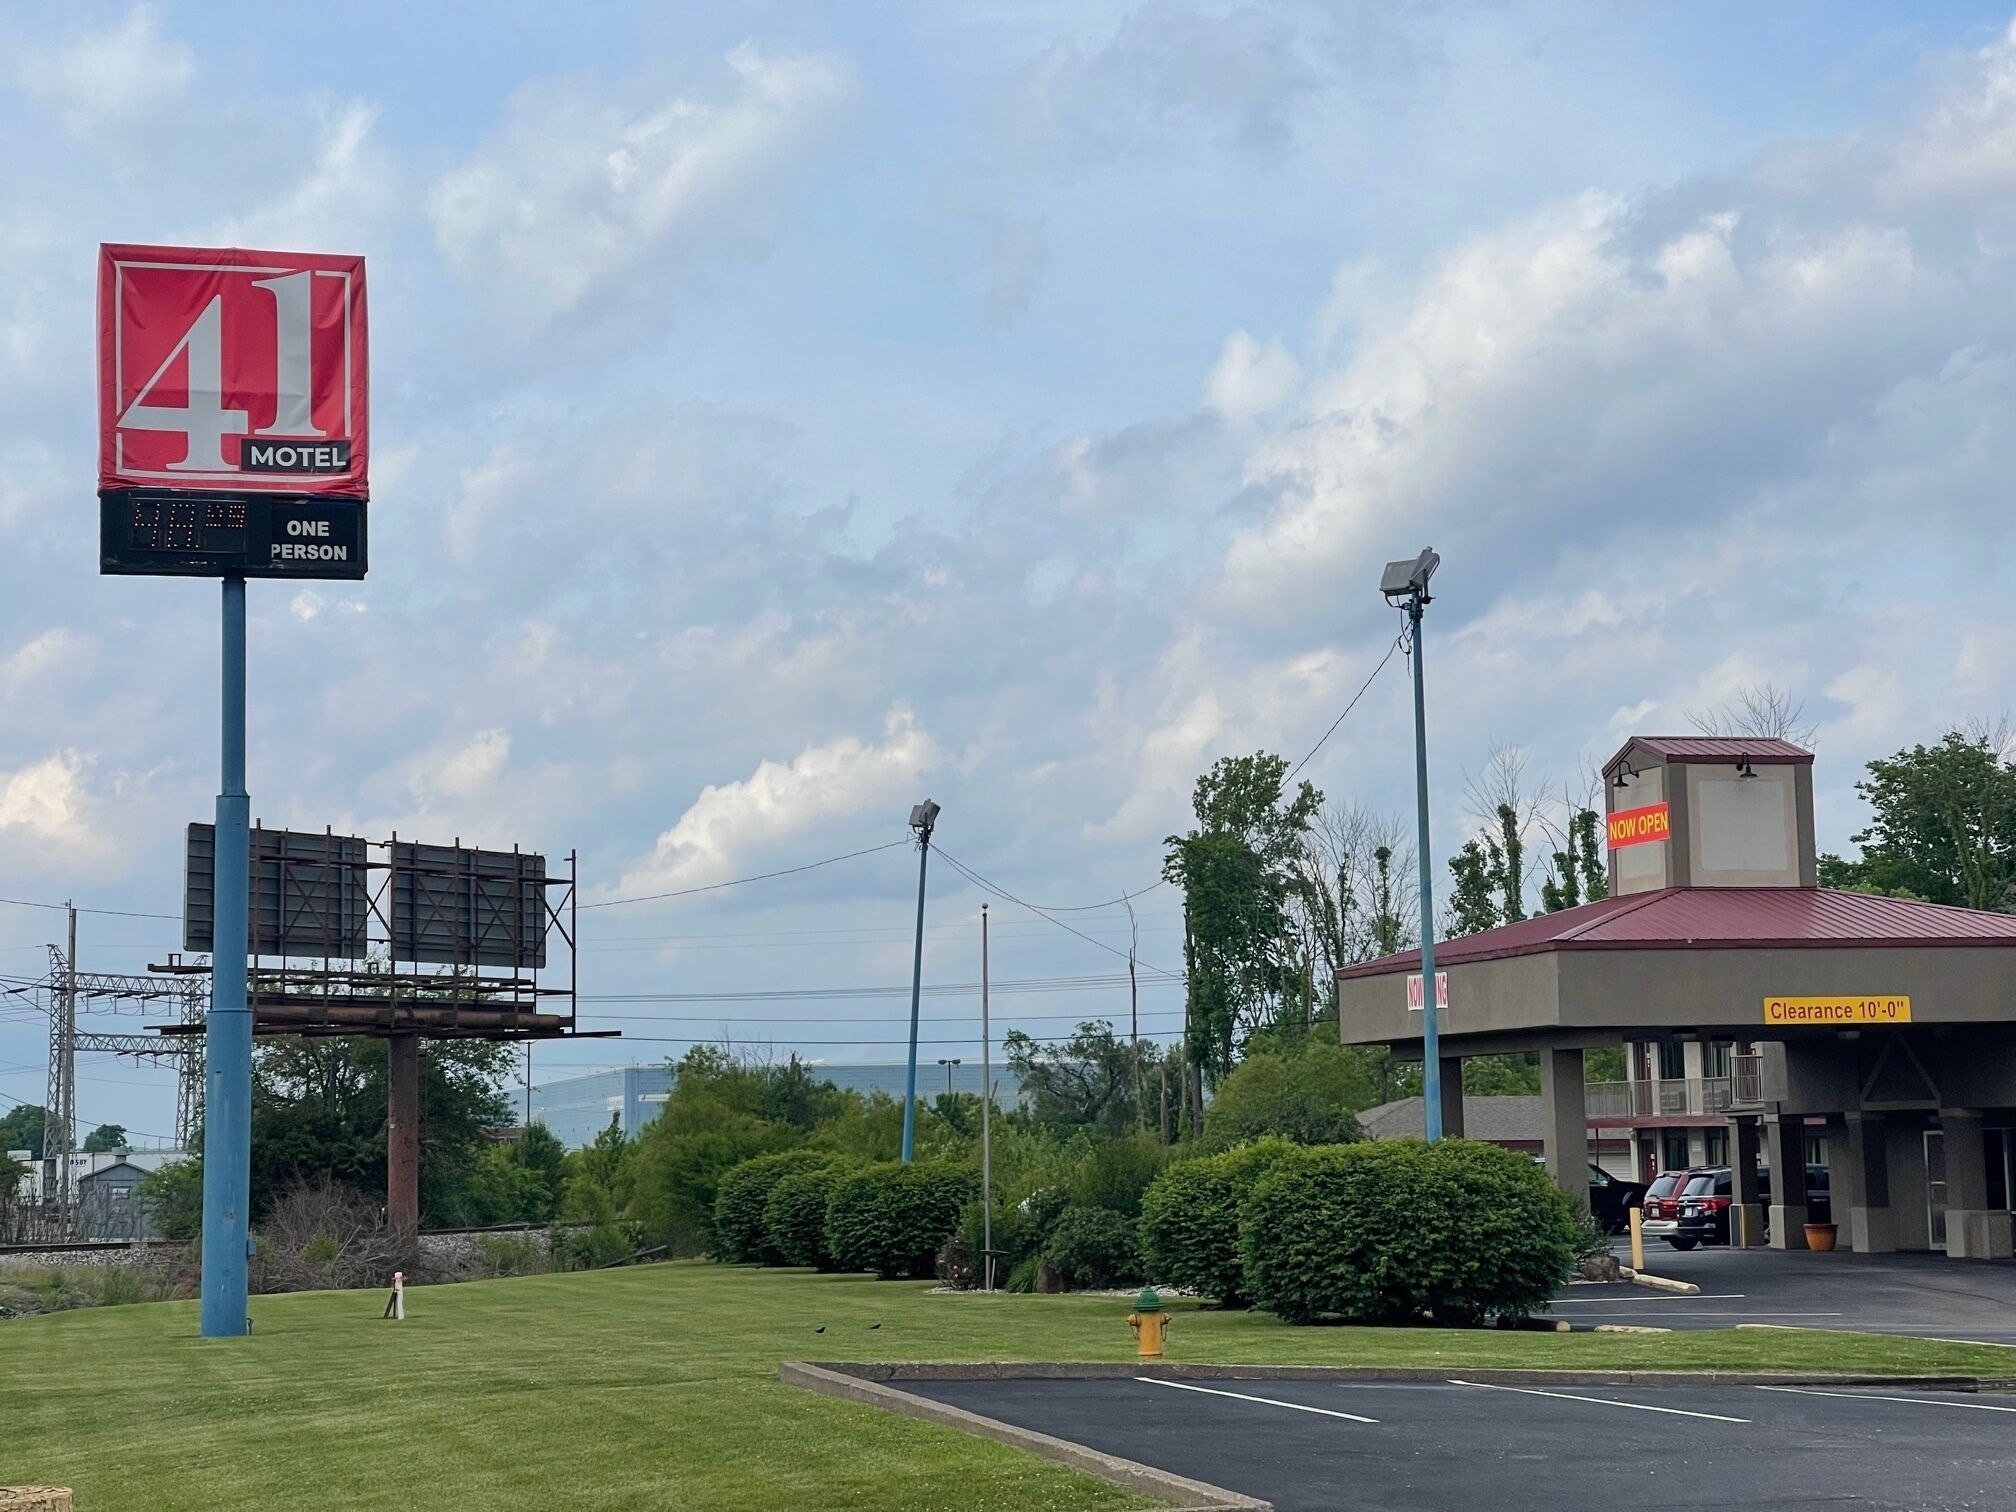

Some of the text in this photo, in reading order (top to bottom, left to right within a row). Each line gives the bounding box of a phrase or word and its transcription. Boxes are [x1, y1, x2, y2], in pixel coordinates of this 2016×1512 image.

[115, 269, 327, 471] 41
[251, 446, 347, 467] MOTEL
[287, 520, 330, 537] ONE
[271, 544, 347, 561] PERSON
[1610, 811, 1668, 840] NOW OPEN
[1770, 1001, 1904, 1019] Clearance 10'-0"
